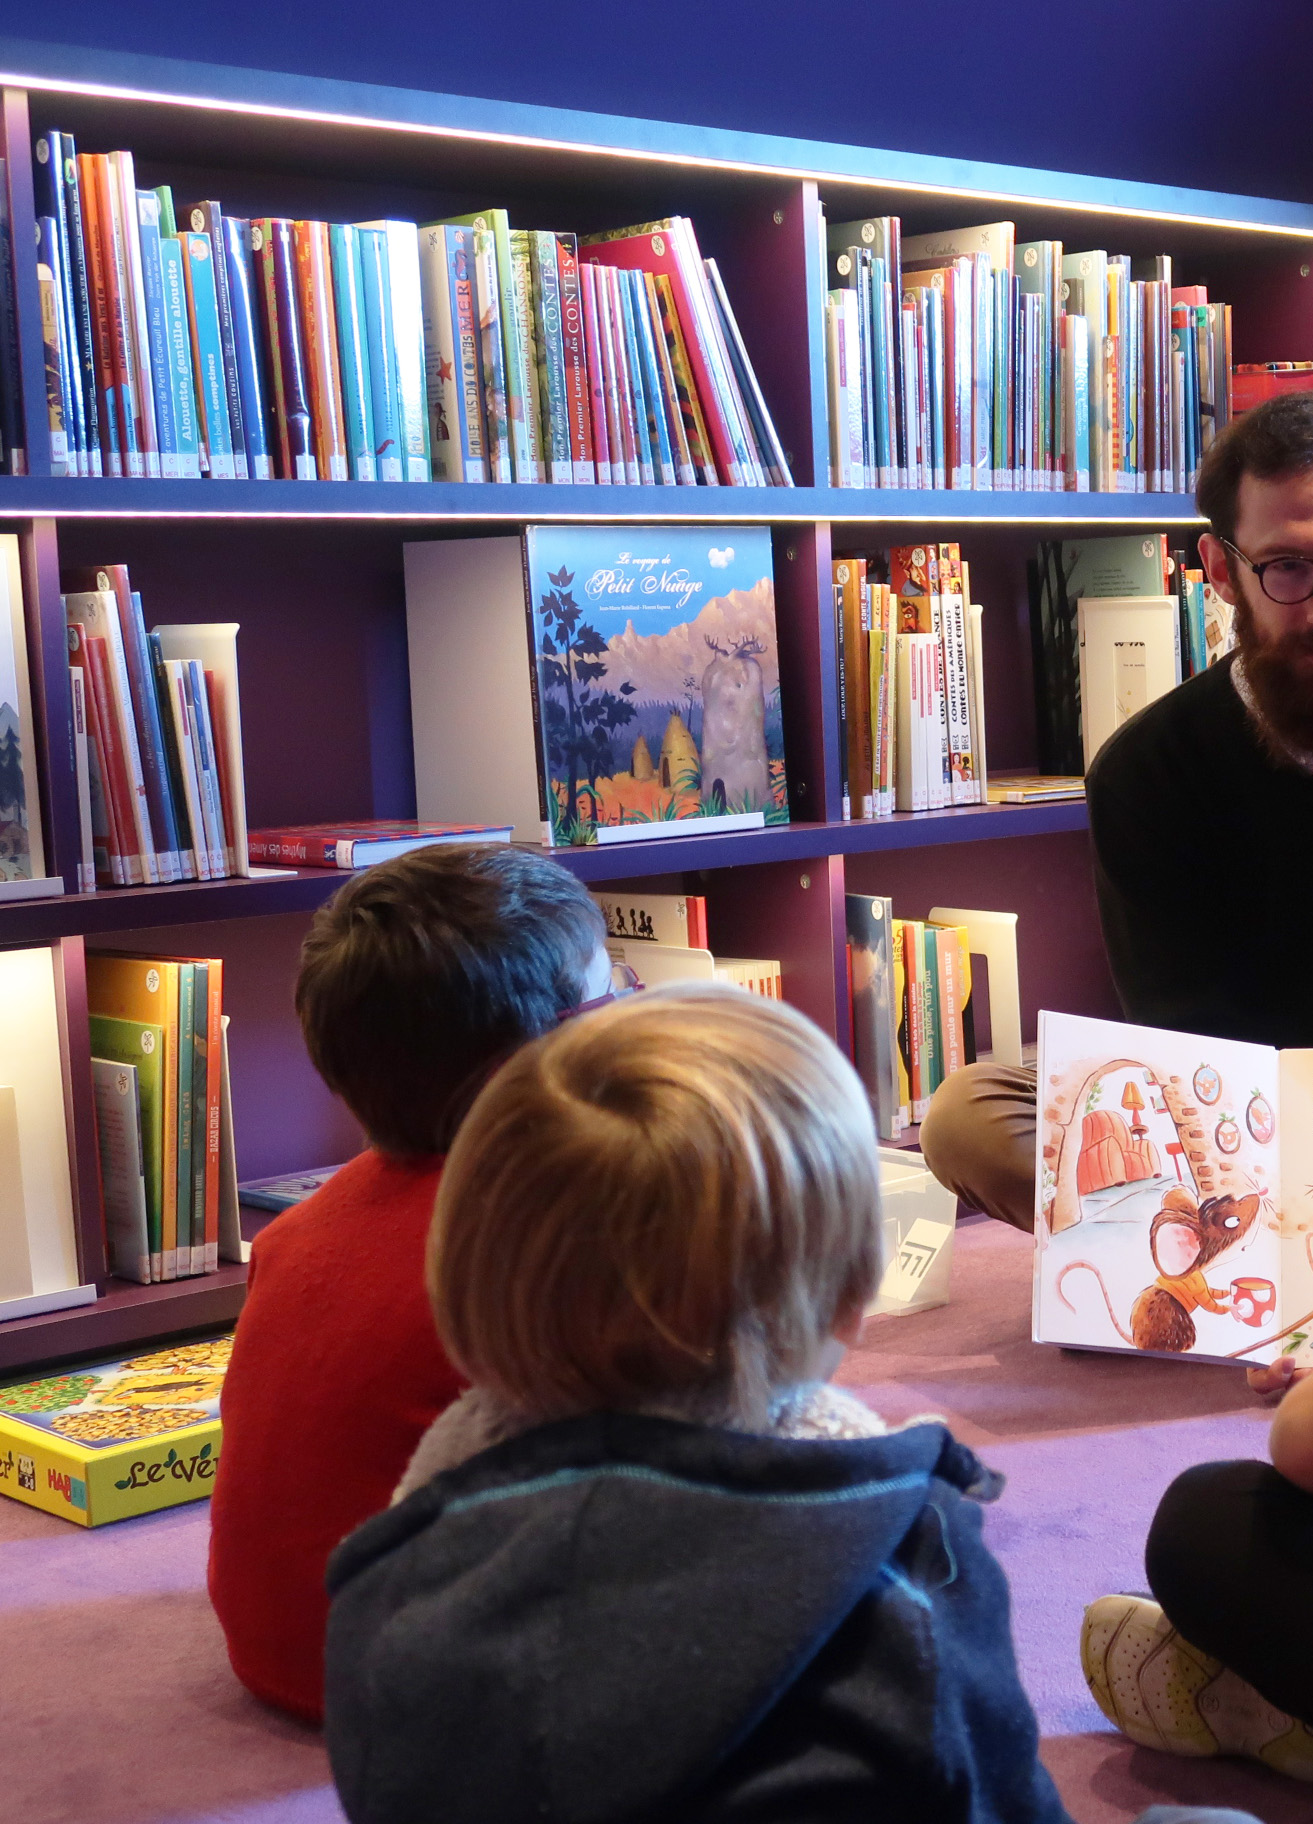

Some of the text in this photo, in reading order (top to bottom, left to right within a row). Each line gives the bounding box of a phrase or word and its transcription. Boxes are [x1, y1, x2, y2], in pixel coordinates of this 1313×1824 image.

[543, 258, 559, 333] CONTES
[561, 259, 579, 334] CONTES
[152, 307, 161, 326] Bleu
[167, 260, 193, 442] Alouette, gentille alouette
[517, 261, 537, 462] Mon Premier Larousse des CHANSONS
[549, 336, 558, 353] des
[569, 336, 579, 353] des
[157, 367, 166, 389] Petit
[208, 353, 220, 411] comptines
[551, 355, 562, 398] Larousse
[571, 355, 582, 398] Larousse
[159, 391, 167, 402] de
[161, 405, 171, 448] aventures
[213, 412, 222, 436] belles
[555, 402, 565, 440] Premier
[574, 401, 585, 440] Premier
[615, 552, 672, 573] Le voyage de
[584, 568, 704, 609] Petit Nuage
[949, 685, 958, 723] CONTES
[944, 951, 958, 1072] Une poule sur un mur
[210, 1105, 219, 1128] CIRCUS
[130, 1461, 165, 1490] Le
